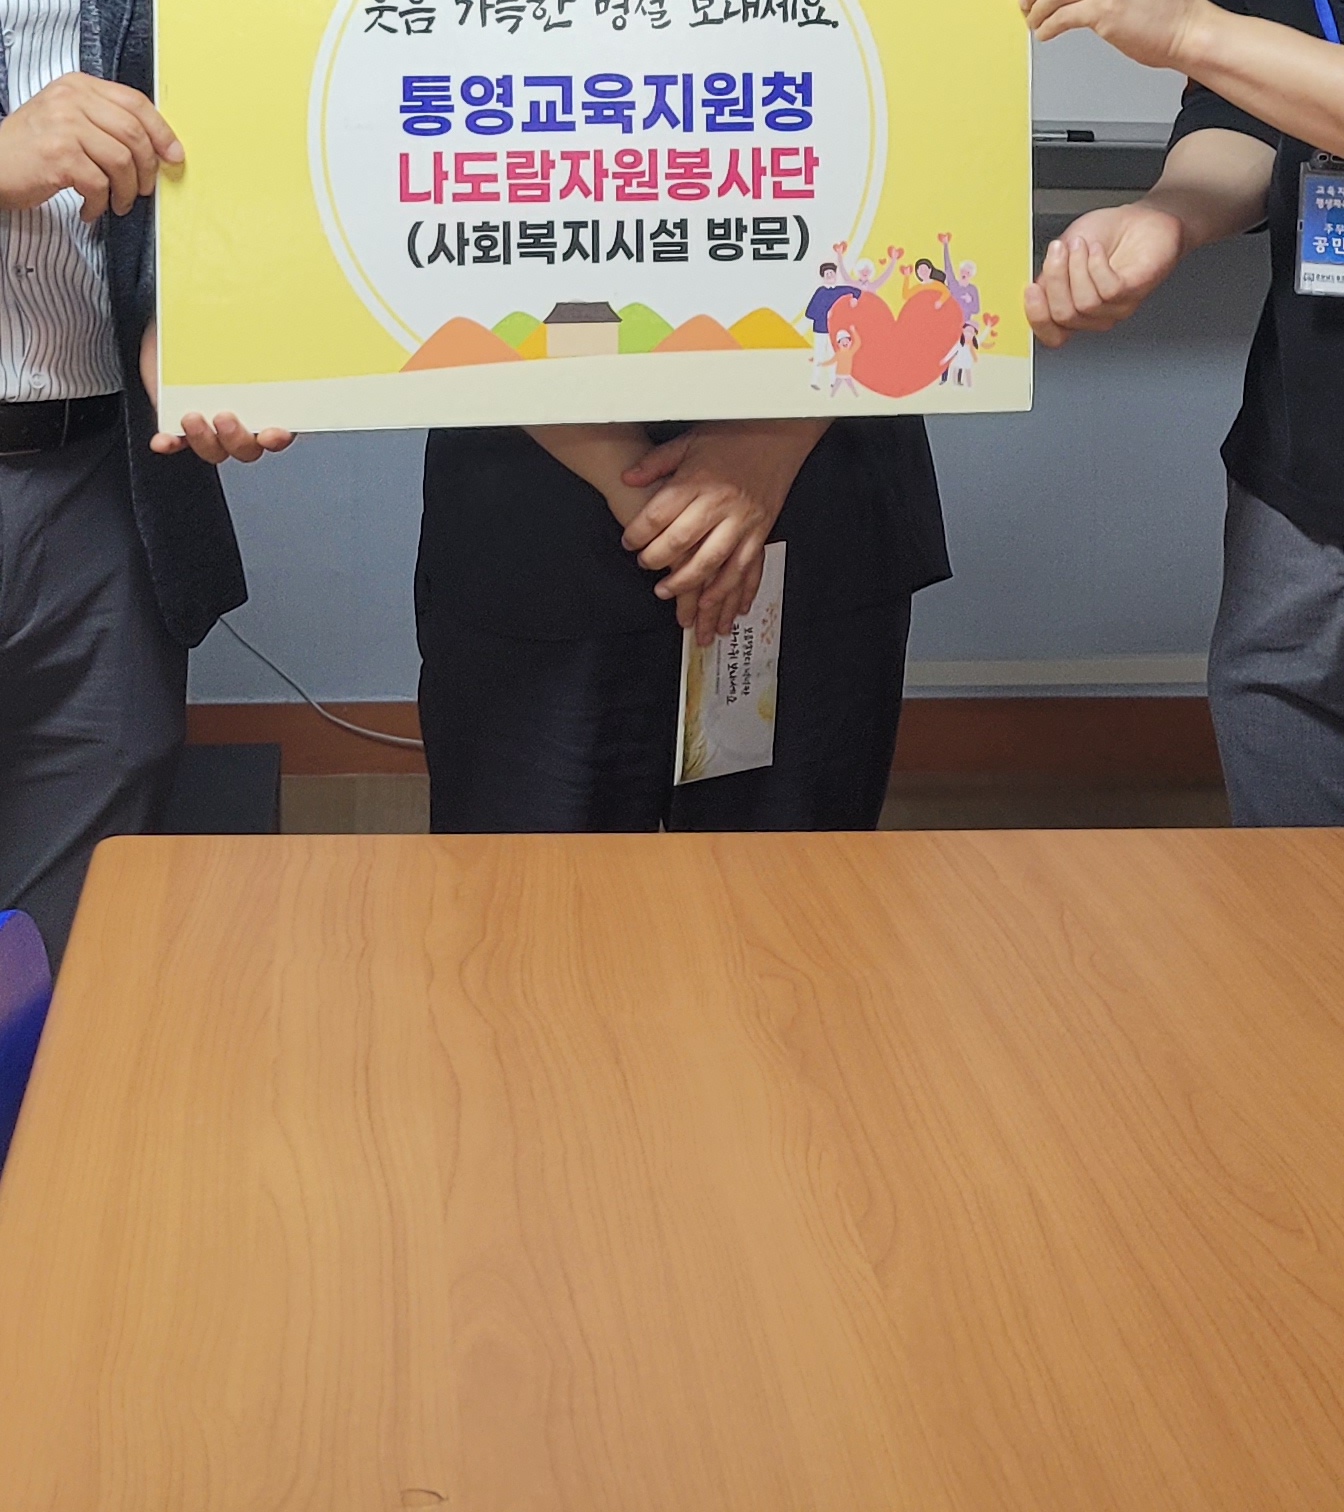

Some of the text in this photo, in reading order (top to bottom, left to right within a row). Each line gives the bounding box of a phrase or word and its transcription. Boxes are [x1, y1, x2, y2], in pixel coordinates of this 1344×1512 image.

[399, 71, 813, 136] 통영교육지원청
[399, 146, 819, 204] 나도람자원봉사단
[407, 215, 810, 269] (사회복지시설 방문)
